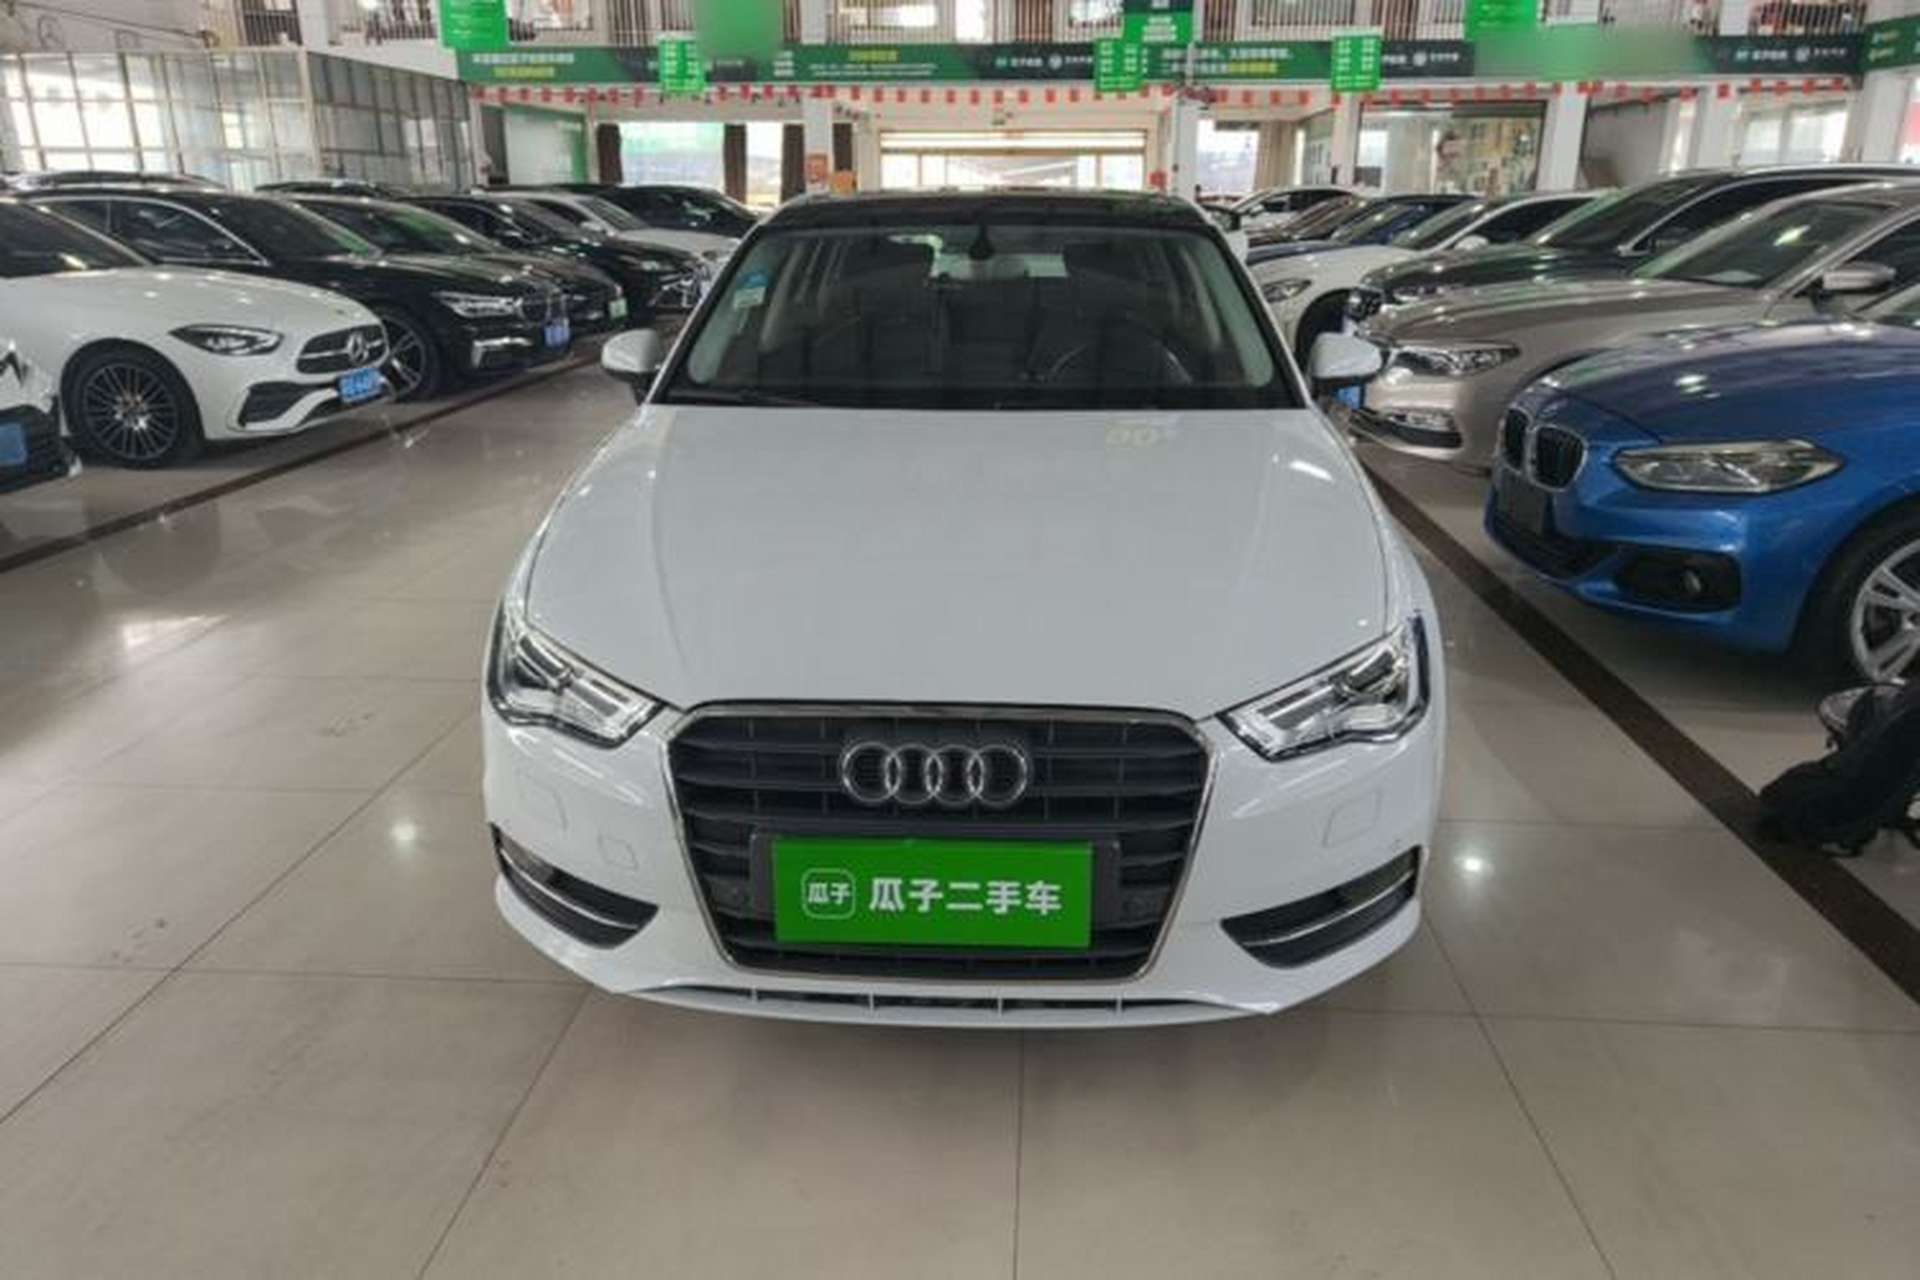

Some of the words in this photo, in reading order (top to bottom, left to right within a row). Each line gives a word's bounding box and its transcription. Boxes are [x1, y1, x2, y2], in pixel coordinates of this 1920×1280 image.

[807, 881, 850, 905] 瓜子
[869, 877, 1062, 915] 瓜子二手车
